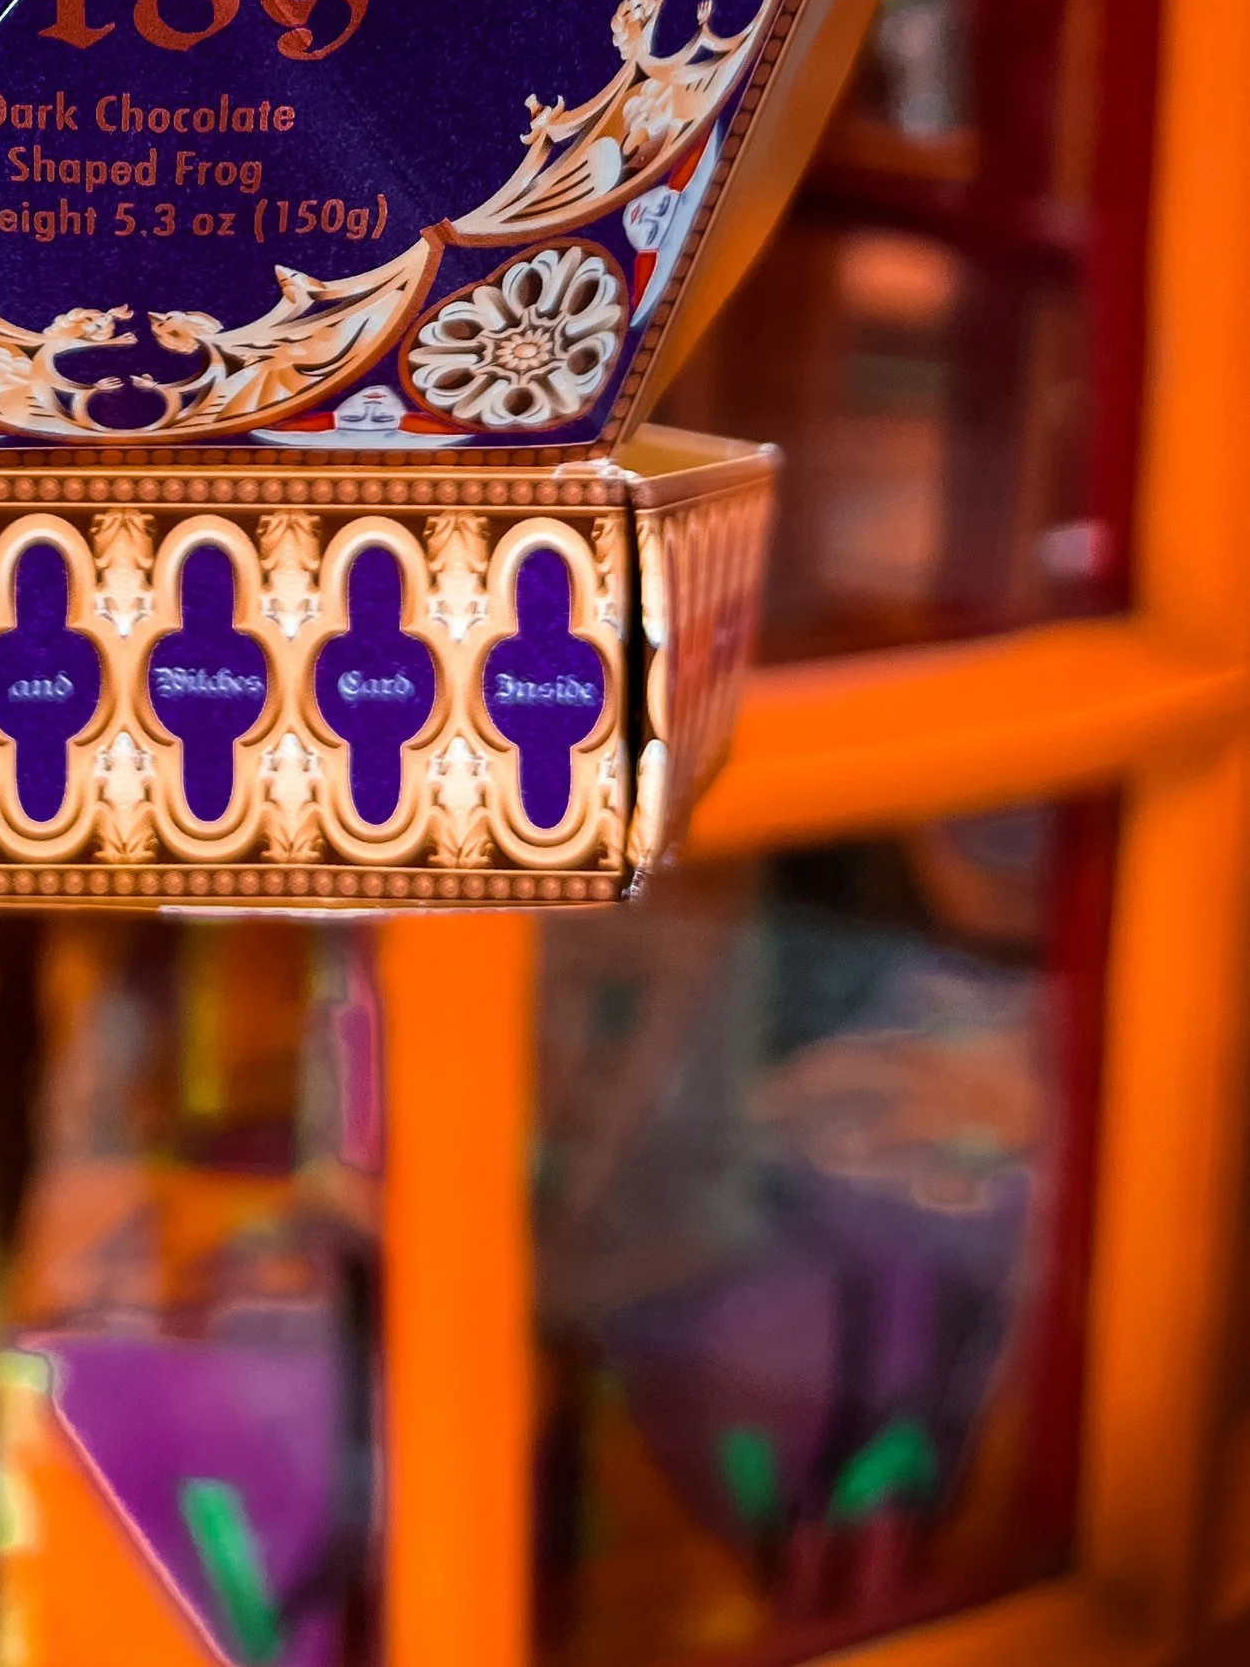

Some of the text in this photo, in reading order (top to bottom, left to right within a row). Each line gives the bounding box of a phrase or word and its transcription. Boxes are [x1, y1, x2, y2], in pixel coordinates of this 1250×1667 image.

[95, 92, 297, 133] Chocolate
[7, 146, 263, 194] Shaped Frog
[114, 202, 176, 237] 5.3
[192, 210, 236, 237] oz
[254, 193, 388, 243] (150g)
[7, 670, 75, 703] and
[153, 666, 265, 699] Witches
[337, 669, 415, 704] Card
[493, 671, 598, 707] Inside
